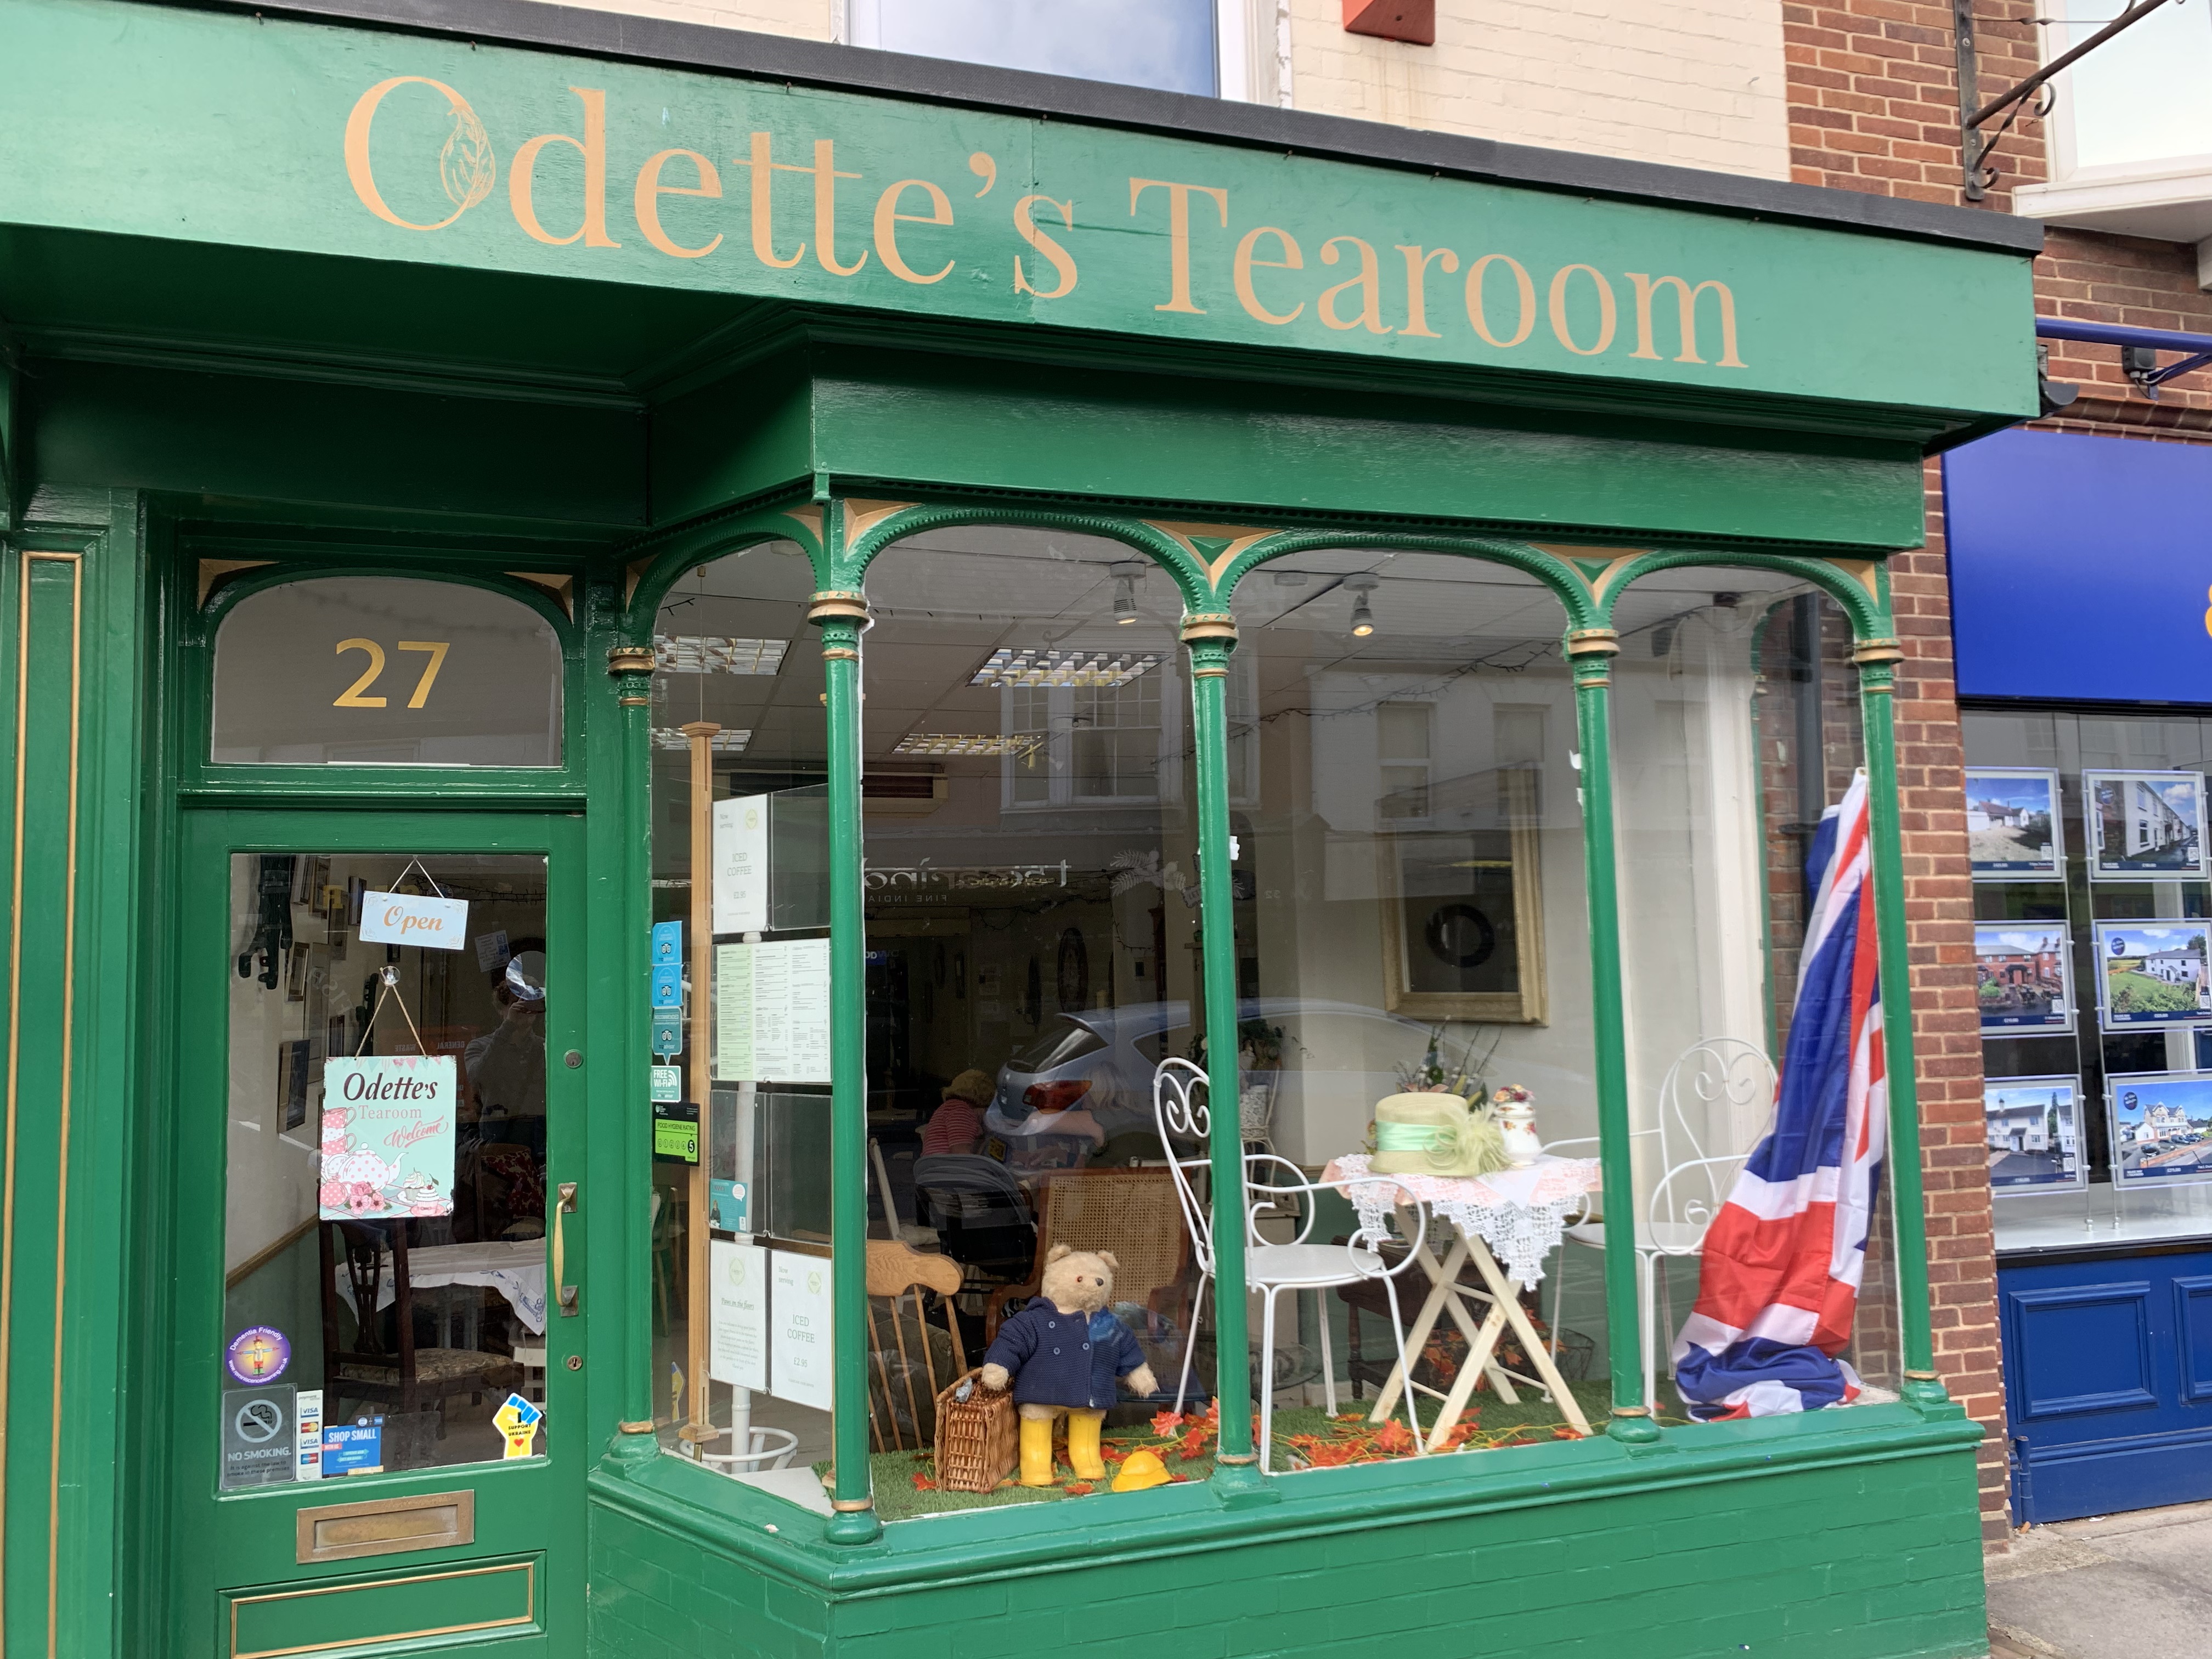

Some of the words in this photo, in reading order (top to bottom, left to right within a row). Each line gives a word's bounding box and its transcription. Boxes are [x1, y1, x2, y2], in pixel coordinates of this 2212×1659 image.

[344, 76, 1077, 298] Odette's
[1130, 177, 1749, 368] Tearoom
[333, 637, 450, 708] 27
[732, 852, 747, 862] ICED
[727, 865, 752, 877] COFFEE
[384, 906, 444, 935] Open
[653, 1069, 668, 1079] FREE
[343, 1073, 438, 1101] Odette's
[358, 1105, 422, 1119] Tearoom
[383, 1115, 449, 1148] Welcome
[689, 1141, 694, 1152] 5
[778, 1277, 794, 1286] serving
[792, 1314, 809, 1327] ICED
[229, 1329, 257, 1351] Dementia
[258, 1327, 283, 1341] Friendly
[787, 1328, 815, 1344] COFFEE
[793, 1357, 808, 1368] £2.95
[329, 1431, 350, 1443] SHOP
[351, 1429, 377, 1441] SMALL
[228, 1452, 242, 1462] NO
[244, 1447, 292, 1460] SMOKING.
